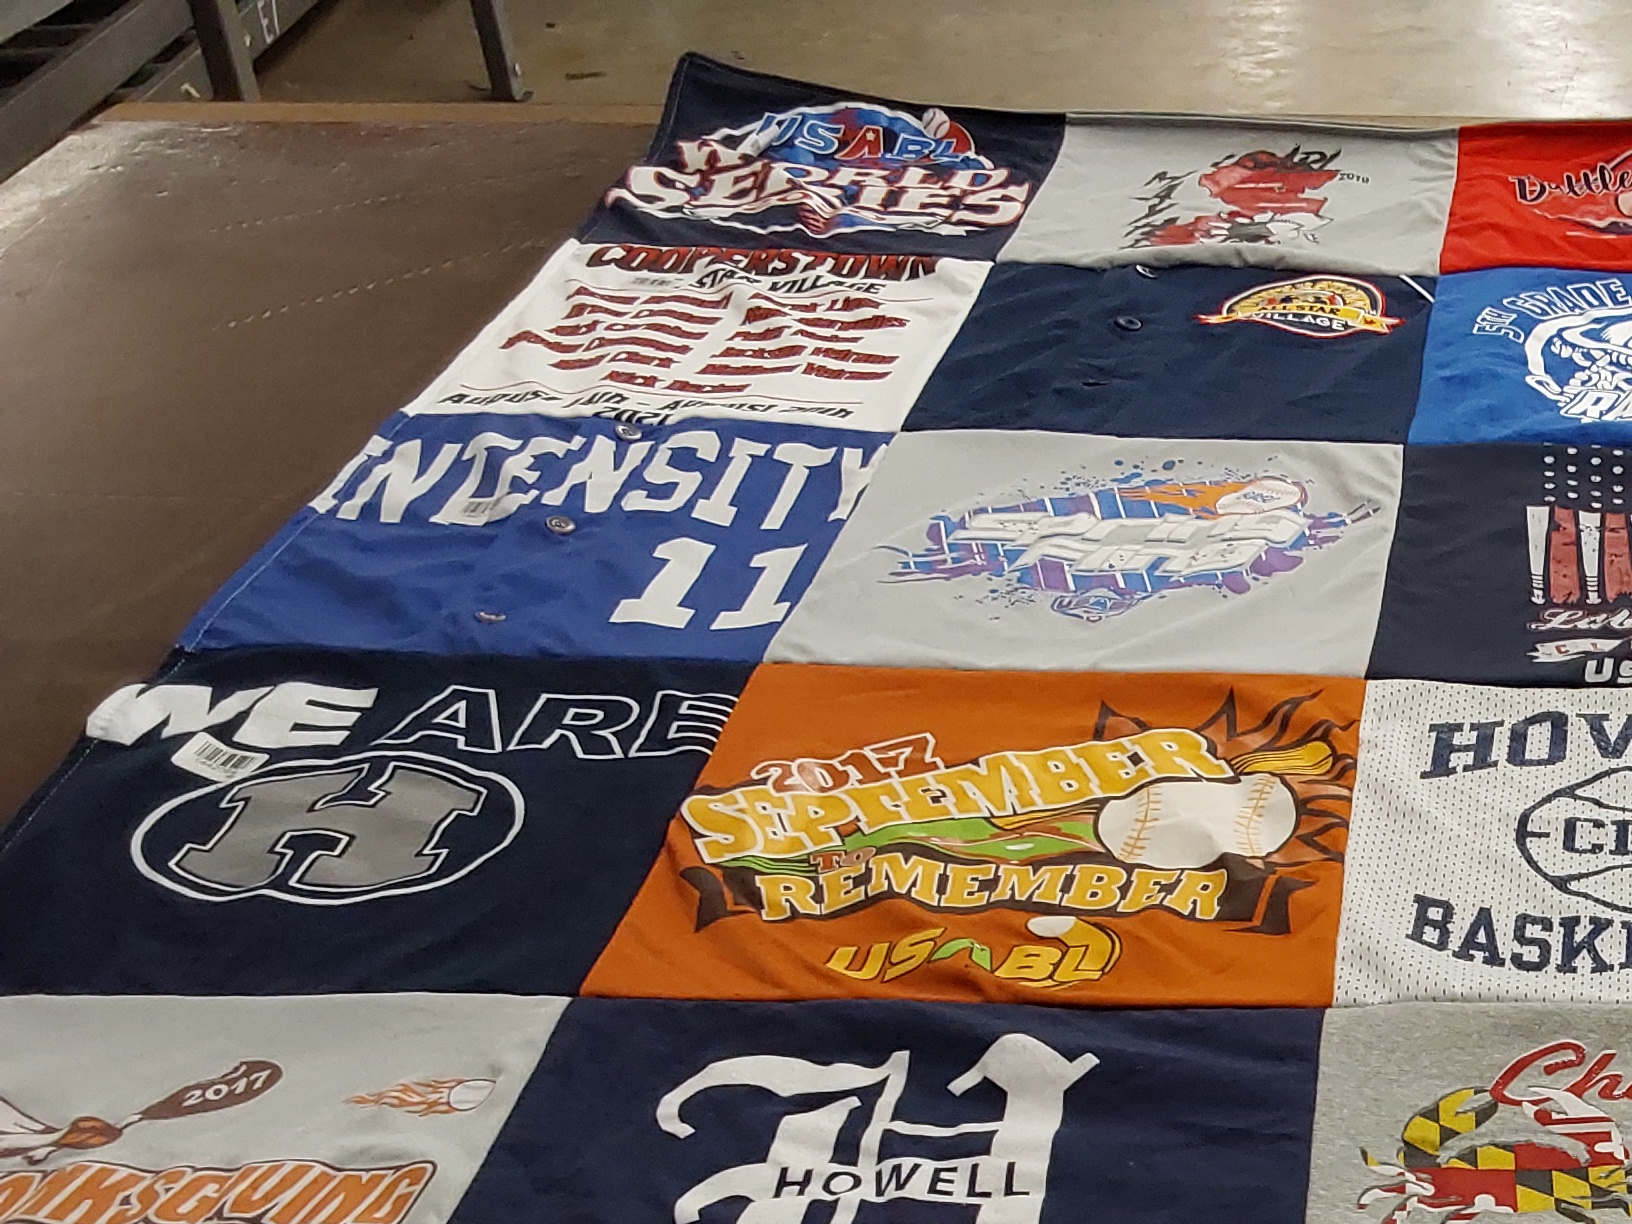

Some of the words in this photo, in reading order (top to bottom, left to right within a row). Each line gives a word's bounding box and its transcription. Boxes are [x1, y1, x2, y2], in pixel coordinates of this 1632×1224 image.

[754, 113, 978, 164] USABL
[606, 163, 1032, 228] SERIES
[586, 243, 939, 281] COOPERSTOWN
[768, 274, 887, 295] VILLAGE
[1251, 311, 1346, 331] VILLAGE
[1503, 278, 1632, 320] GRADE
[308, 431, 888, 531] INTENSITY
[609, 536, 810, 632] 11
[85, 680, 380, 748] WE
[371, 684, 742, 760] ARE
[750, 732, 945, 794] 2017
[681, 726, 1236, 866] SEPTEMBER
[755, 853, 1229, 921] REMEMBER
[808, 845, 878, 875] TO
[826, 914, 1125, 989] USABL
[180, 1069, 271, 1108] 2017
[772, 1160, 1031, 1199] HOWELL
